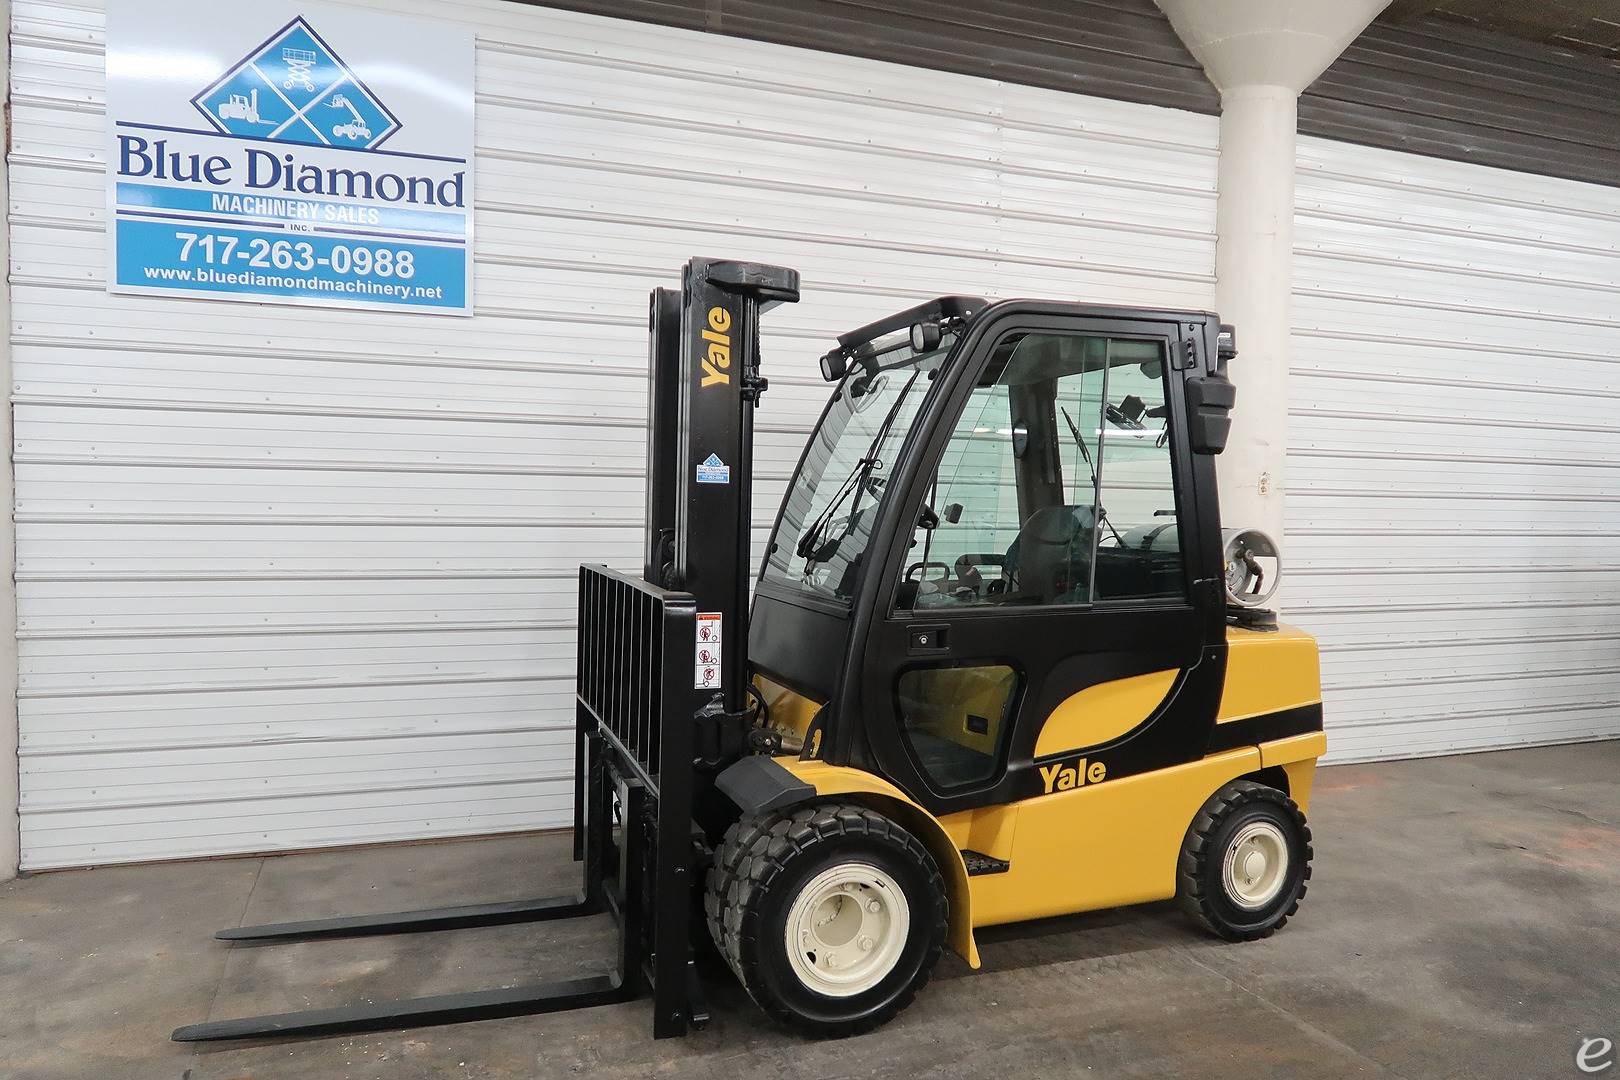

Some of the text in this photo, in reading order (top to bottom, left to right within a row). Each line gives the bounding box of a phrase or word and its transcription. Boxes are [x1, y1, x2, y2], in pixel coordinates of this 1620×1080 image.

[117, 135, 466, 208] Blue Diamond
[212, 193, 380, 225] MACHINERY SALES
[290, 224, 311, 232] INC.
[175, 232, 415, 279] 717-263-0988
[144, 267, 442, 299] www.bluediamondmachinery.net
[701, 306, 731, 387] Yale
[1039, 758, 1107, 794] Yale
